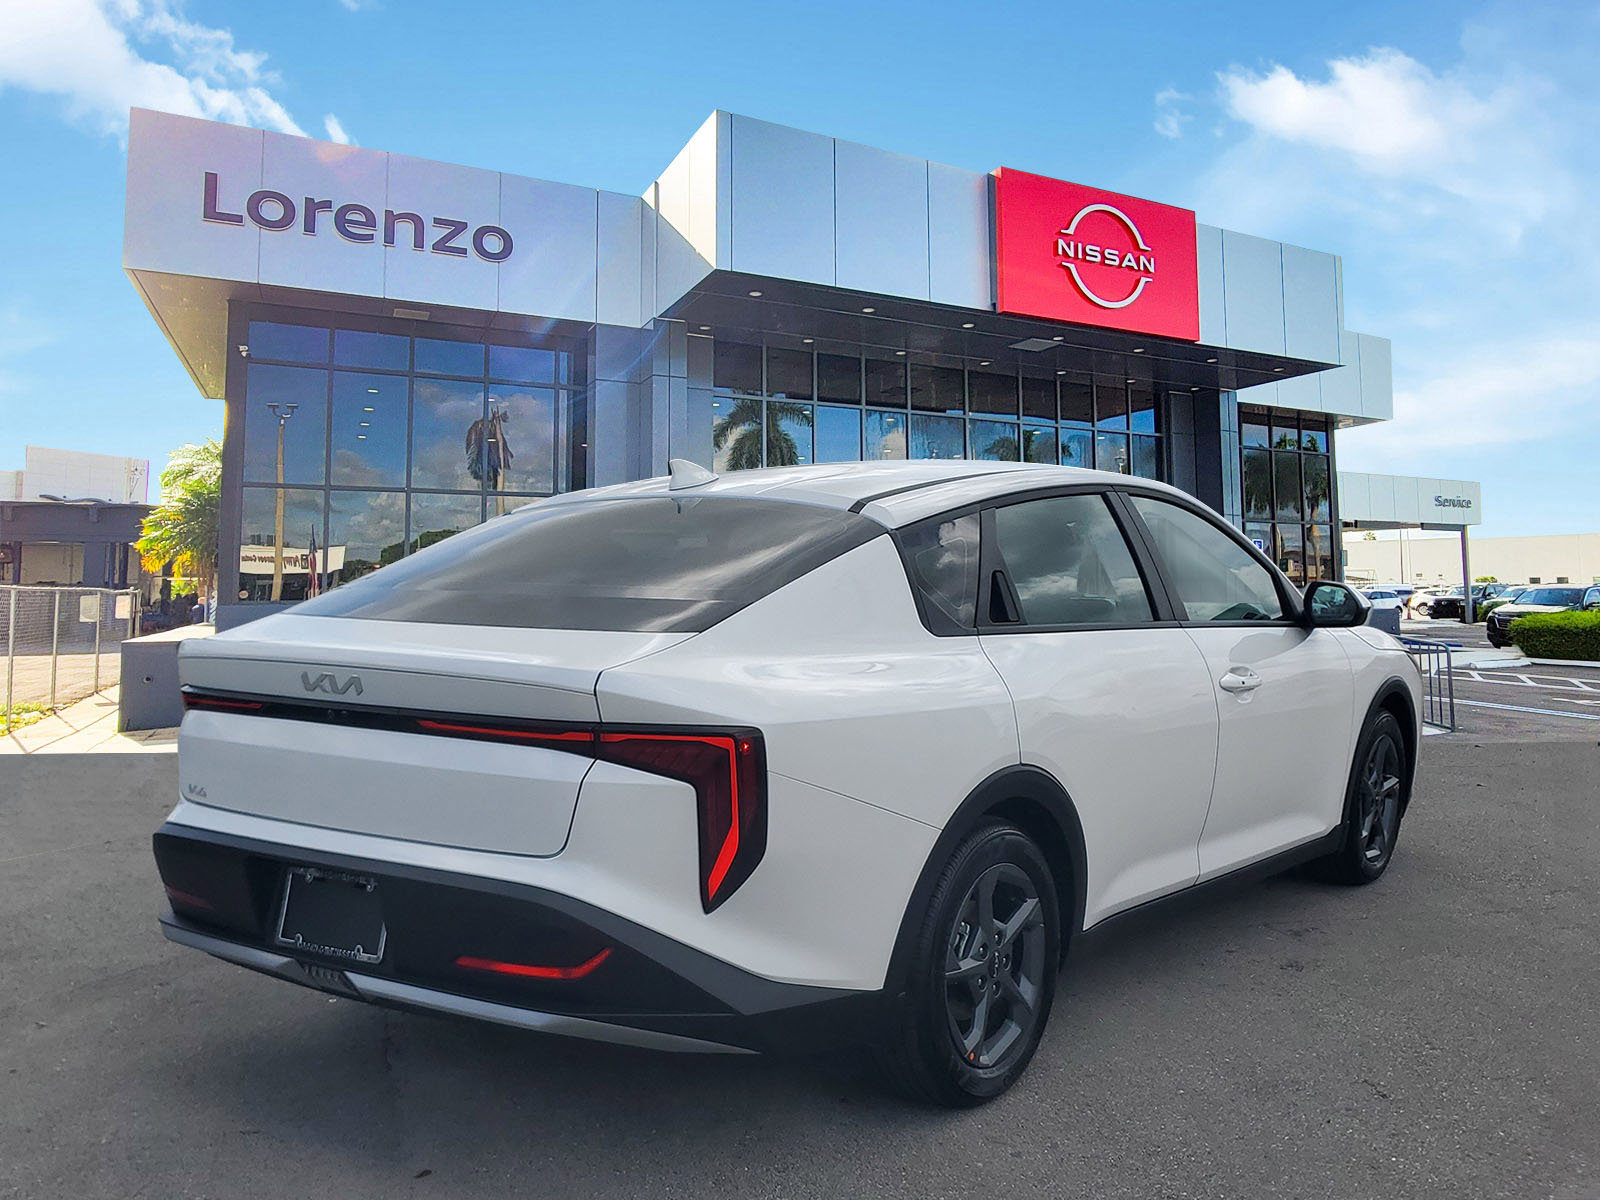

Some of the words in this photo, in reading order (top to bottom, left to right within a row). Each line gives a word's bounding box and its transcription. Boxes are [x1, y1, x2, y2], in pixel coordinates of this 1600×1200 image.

[202, 171, 514, 262] Lorenzo
[1057, 238, 1155, 273] NISSAN
[1434, 495, 1472, 508] Service
